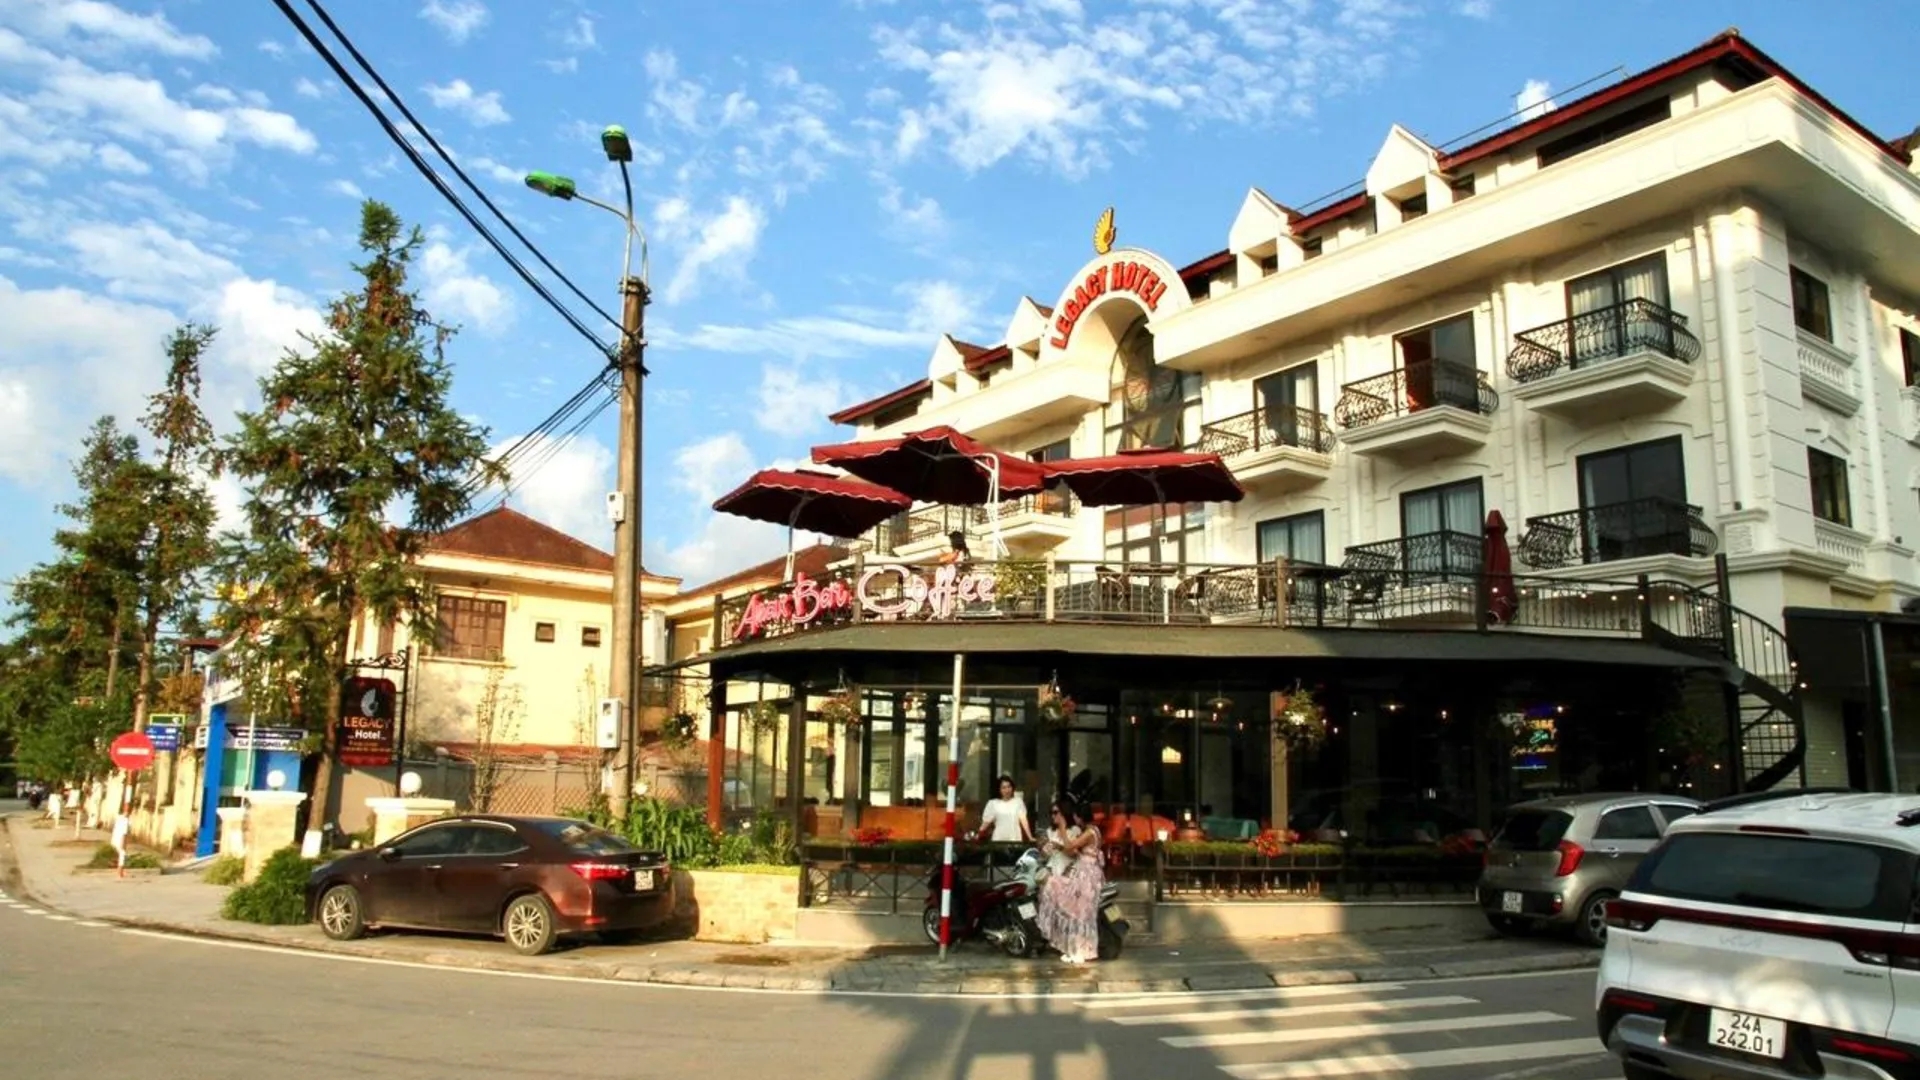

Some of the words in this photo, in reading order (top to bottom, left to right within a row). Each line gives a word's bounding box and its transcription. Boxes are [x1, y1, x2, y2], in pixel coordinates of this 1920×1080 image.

[1050, 265, 1108, 350] LEGACY
[1110, 261, 1168, 313] HOTEL
[857, 564, 996, 622] Coffee
[343, 716, 392, 729] LEGACY
[354, 729, 381, 740] Hotel
[1730, 1013, 1763, 1034] 24A
[1715, 1028, 1774, 1055] 242.01
